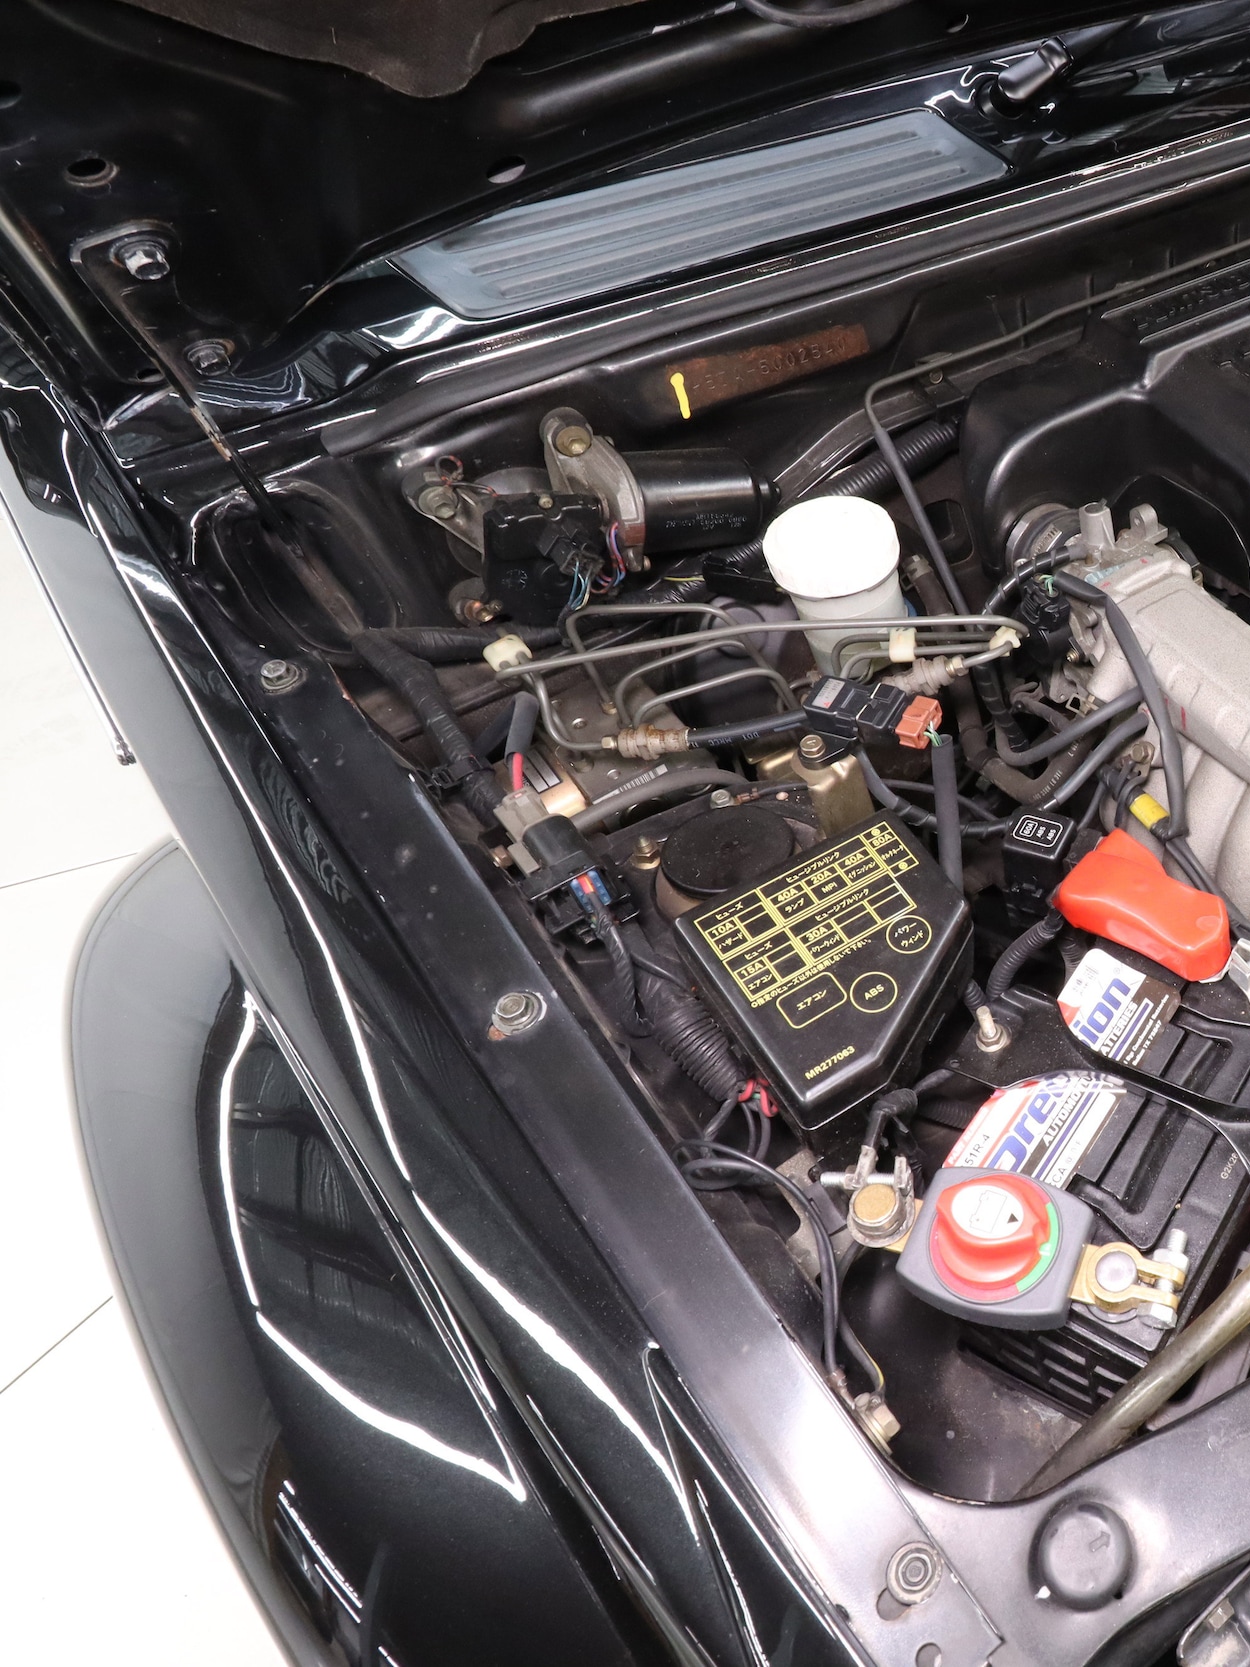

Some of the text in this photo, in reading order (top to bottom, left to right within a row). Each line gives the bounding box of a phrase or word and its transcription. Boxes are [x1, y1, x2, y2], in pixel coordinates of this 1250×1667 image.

[844, 853, 864, 867] 40A
[810, 870, 833, 885] 20A
[777, 887, 799, 902] 40A
[821, 881, 838, 894] MPI
[711, 922, 735, 937] 10A
[806, 926, 829, 941] 30A
[740, 962, 764, 978] 15A
[864, 984, 885, 1000] ABS
[1099, 1001, 1138, 1057] ATTERIES
[804, 1045, 856, 1080] MR277063
[961, 1132, 990, 1168] 51R-4
